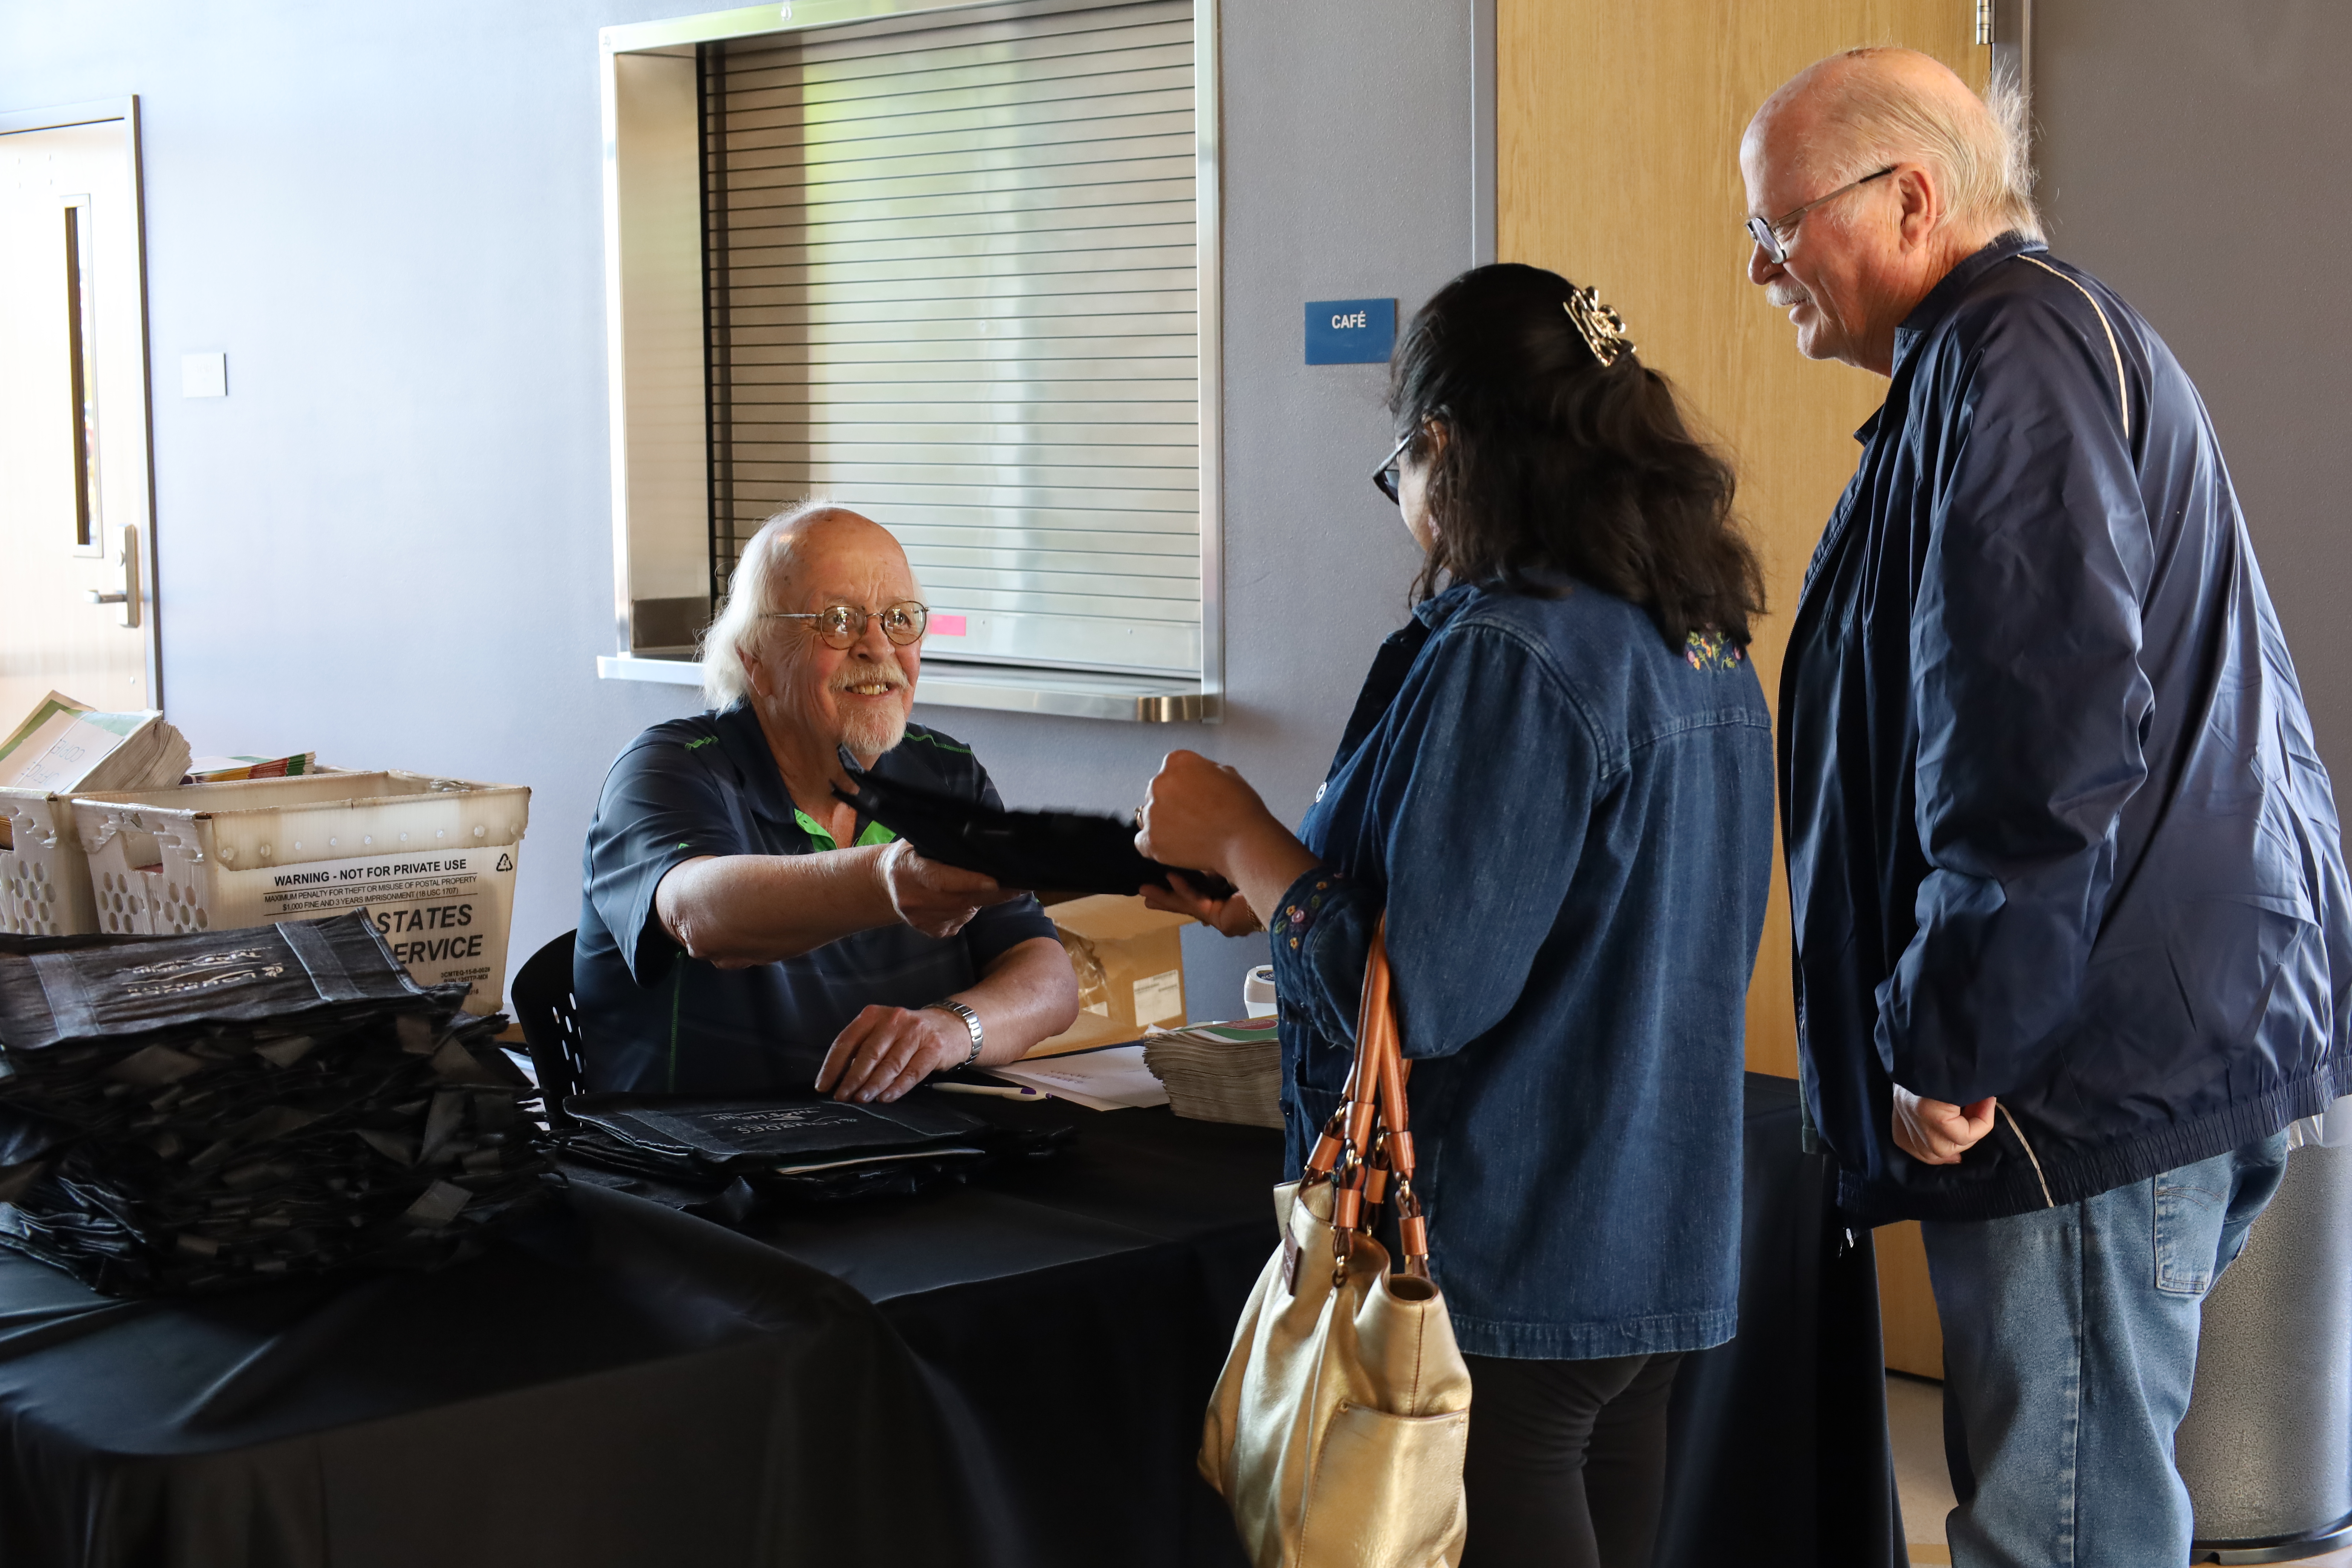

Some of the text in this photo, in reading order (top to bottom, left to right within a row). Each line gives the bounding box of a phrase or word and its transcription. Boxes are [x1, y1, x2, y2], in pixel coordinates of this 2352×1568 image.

[1331, 310, 1366, 329] CAFÉ
[48, 740, 85, 763] COPIE
[274, 871, 329, 886] WARNING
[340, 868, 363, 880] NOT
[367, 866, 390, 877] FOR
[394, 861, 440, 875] PRIVATE
[444, 859, 467, 870] USE
[265, 893, 297, 903] MAXIMUM
[298, 890, 328, 899] PENALTY
[344, 886, 366, 894] THEFT
[378, 883, 403, 891] MISUSE
[415, 879, 441, 888] POSTAL
[441, 876, 477, 885] PROPERTY
[340, 896, 363, 905] YEARS
[364, 891, 416, 903] IMPRISONMENT
[416, 891, 426, 899] (18
[443, 887, 459, 896] 1707)
[376, 904, 473, 935] STATES
[394, 934, 483, 965] ERVICE
